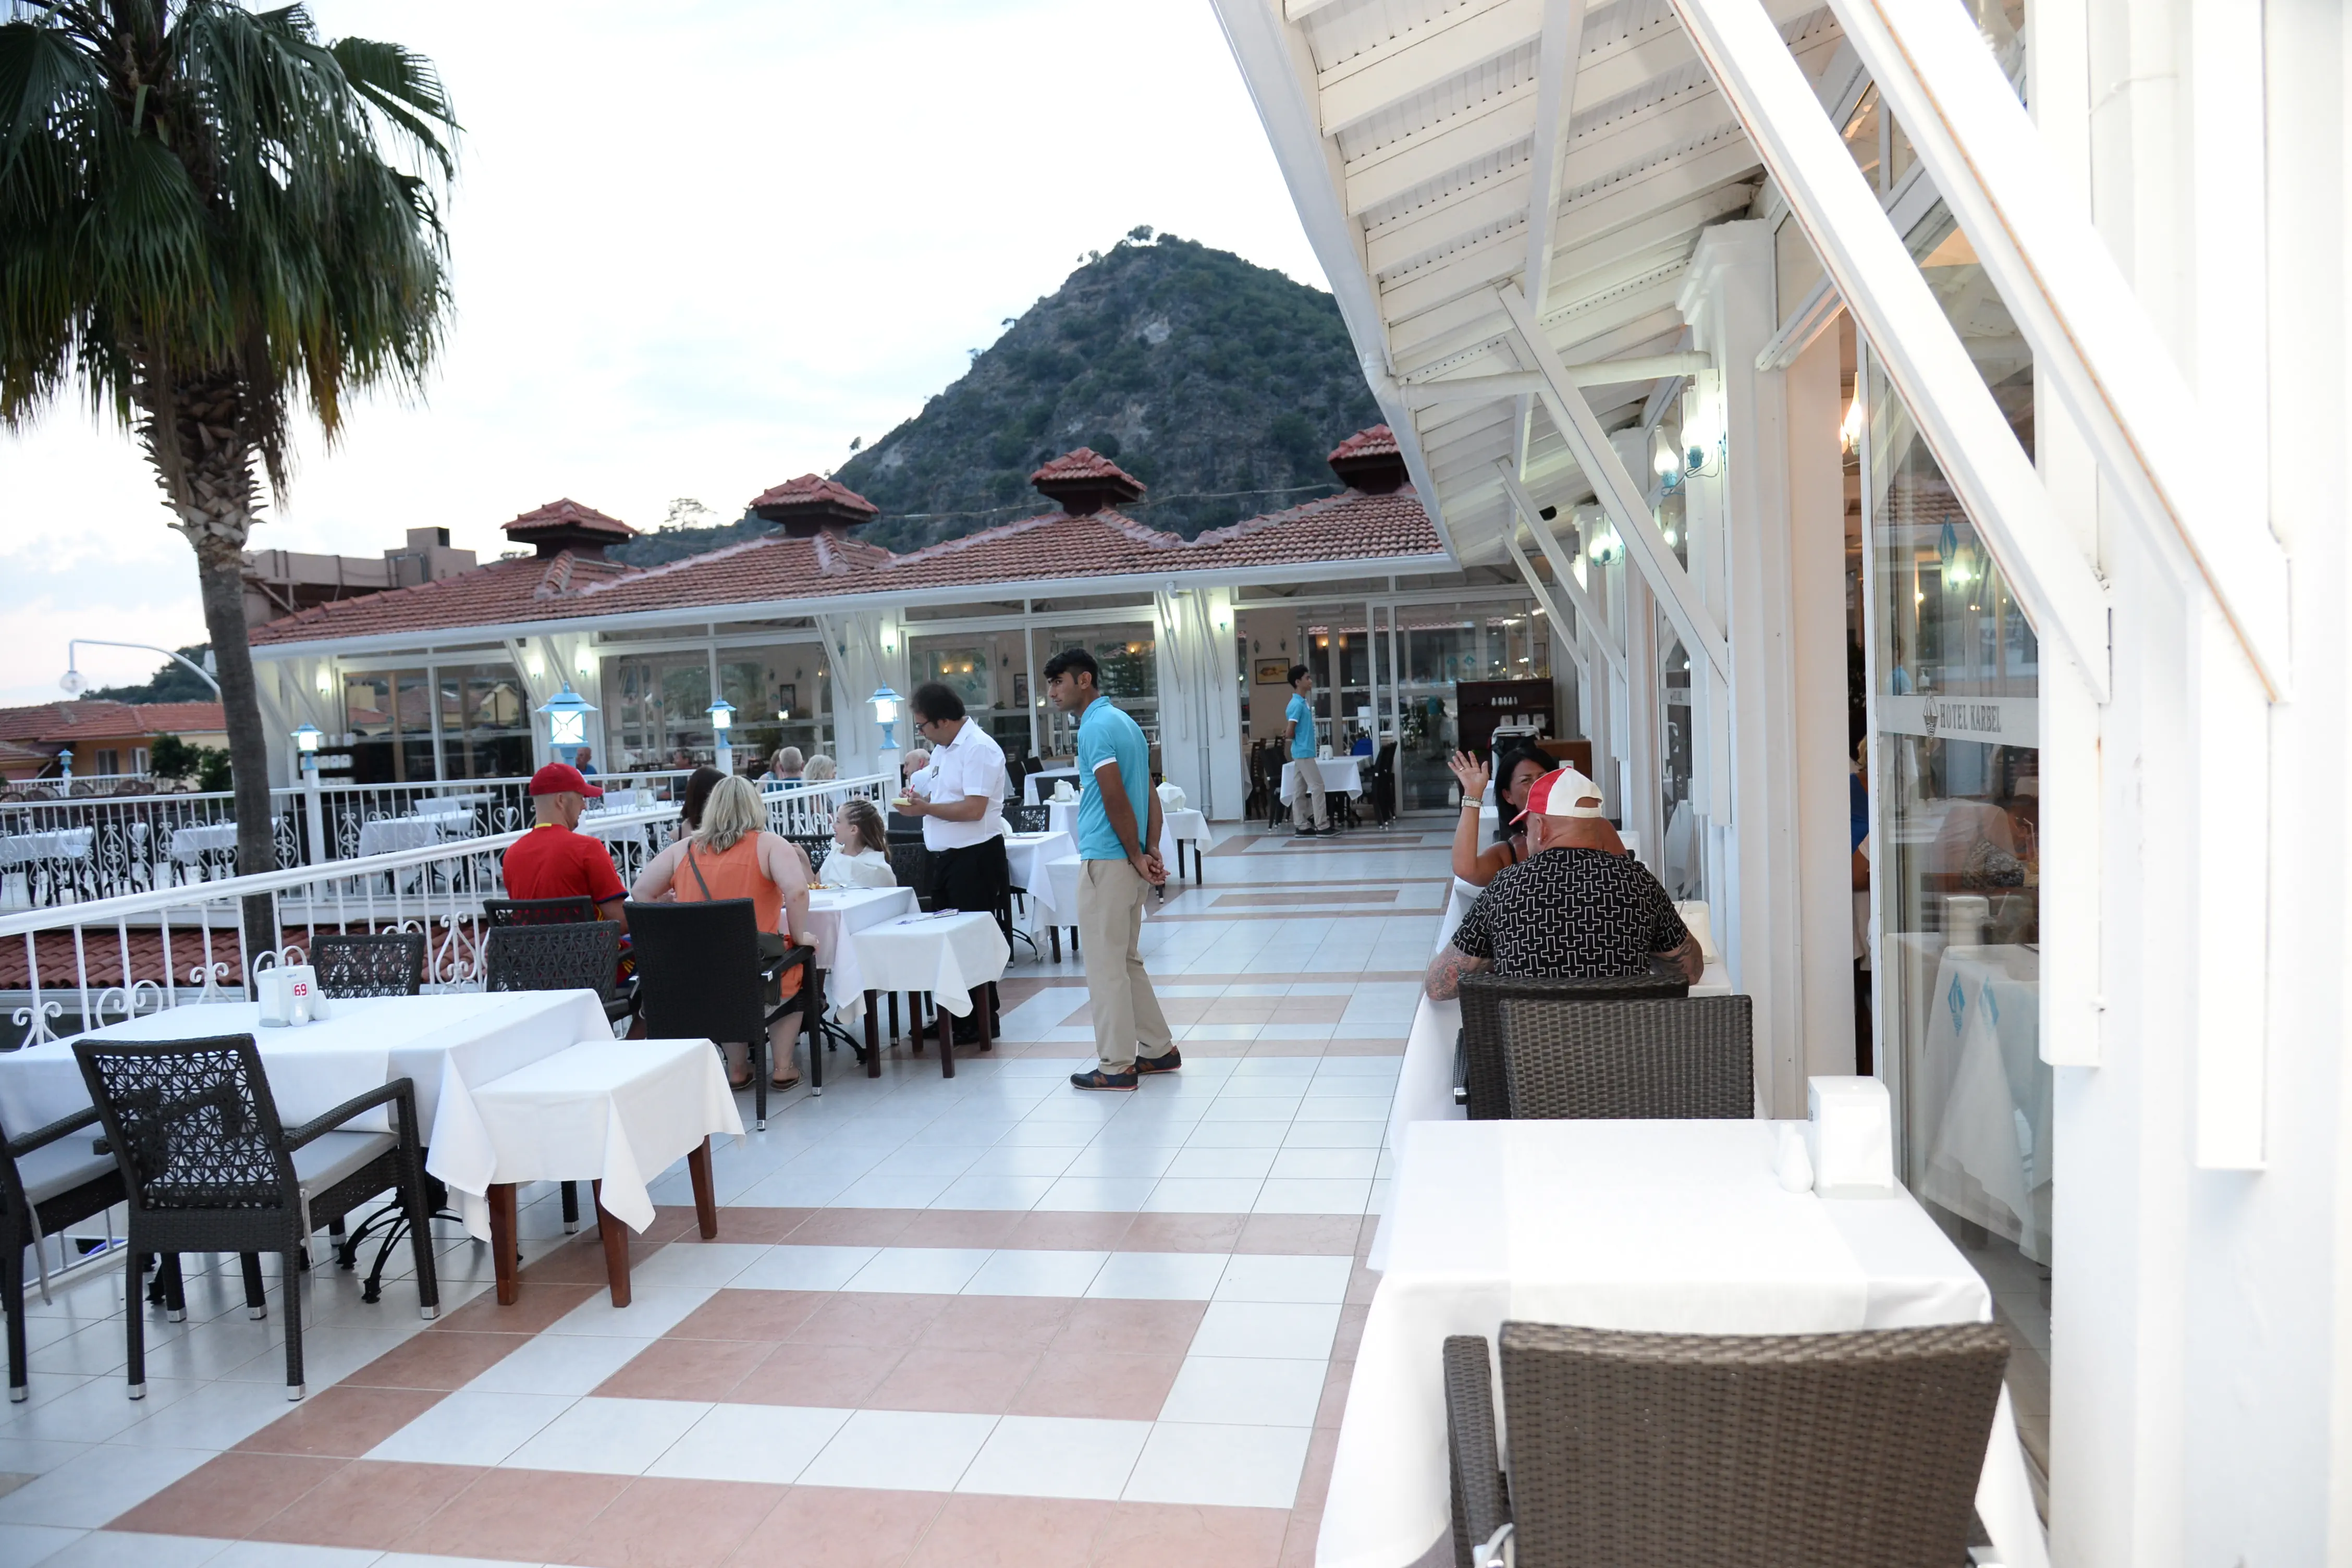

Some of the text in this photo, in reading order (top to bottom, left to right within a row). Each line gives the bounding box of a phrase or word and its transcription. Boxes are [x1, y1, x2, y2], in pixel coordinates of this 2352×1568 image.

[1940, 704, 2002, 732] HOTEL KARBEL
[294, 983, 307, 996] 69
